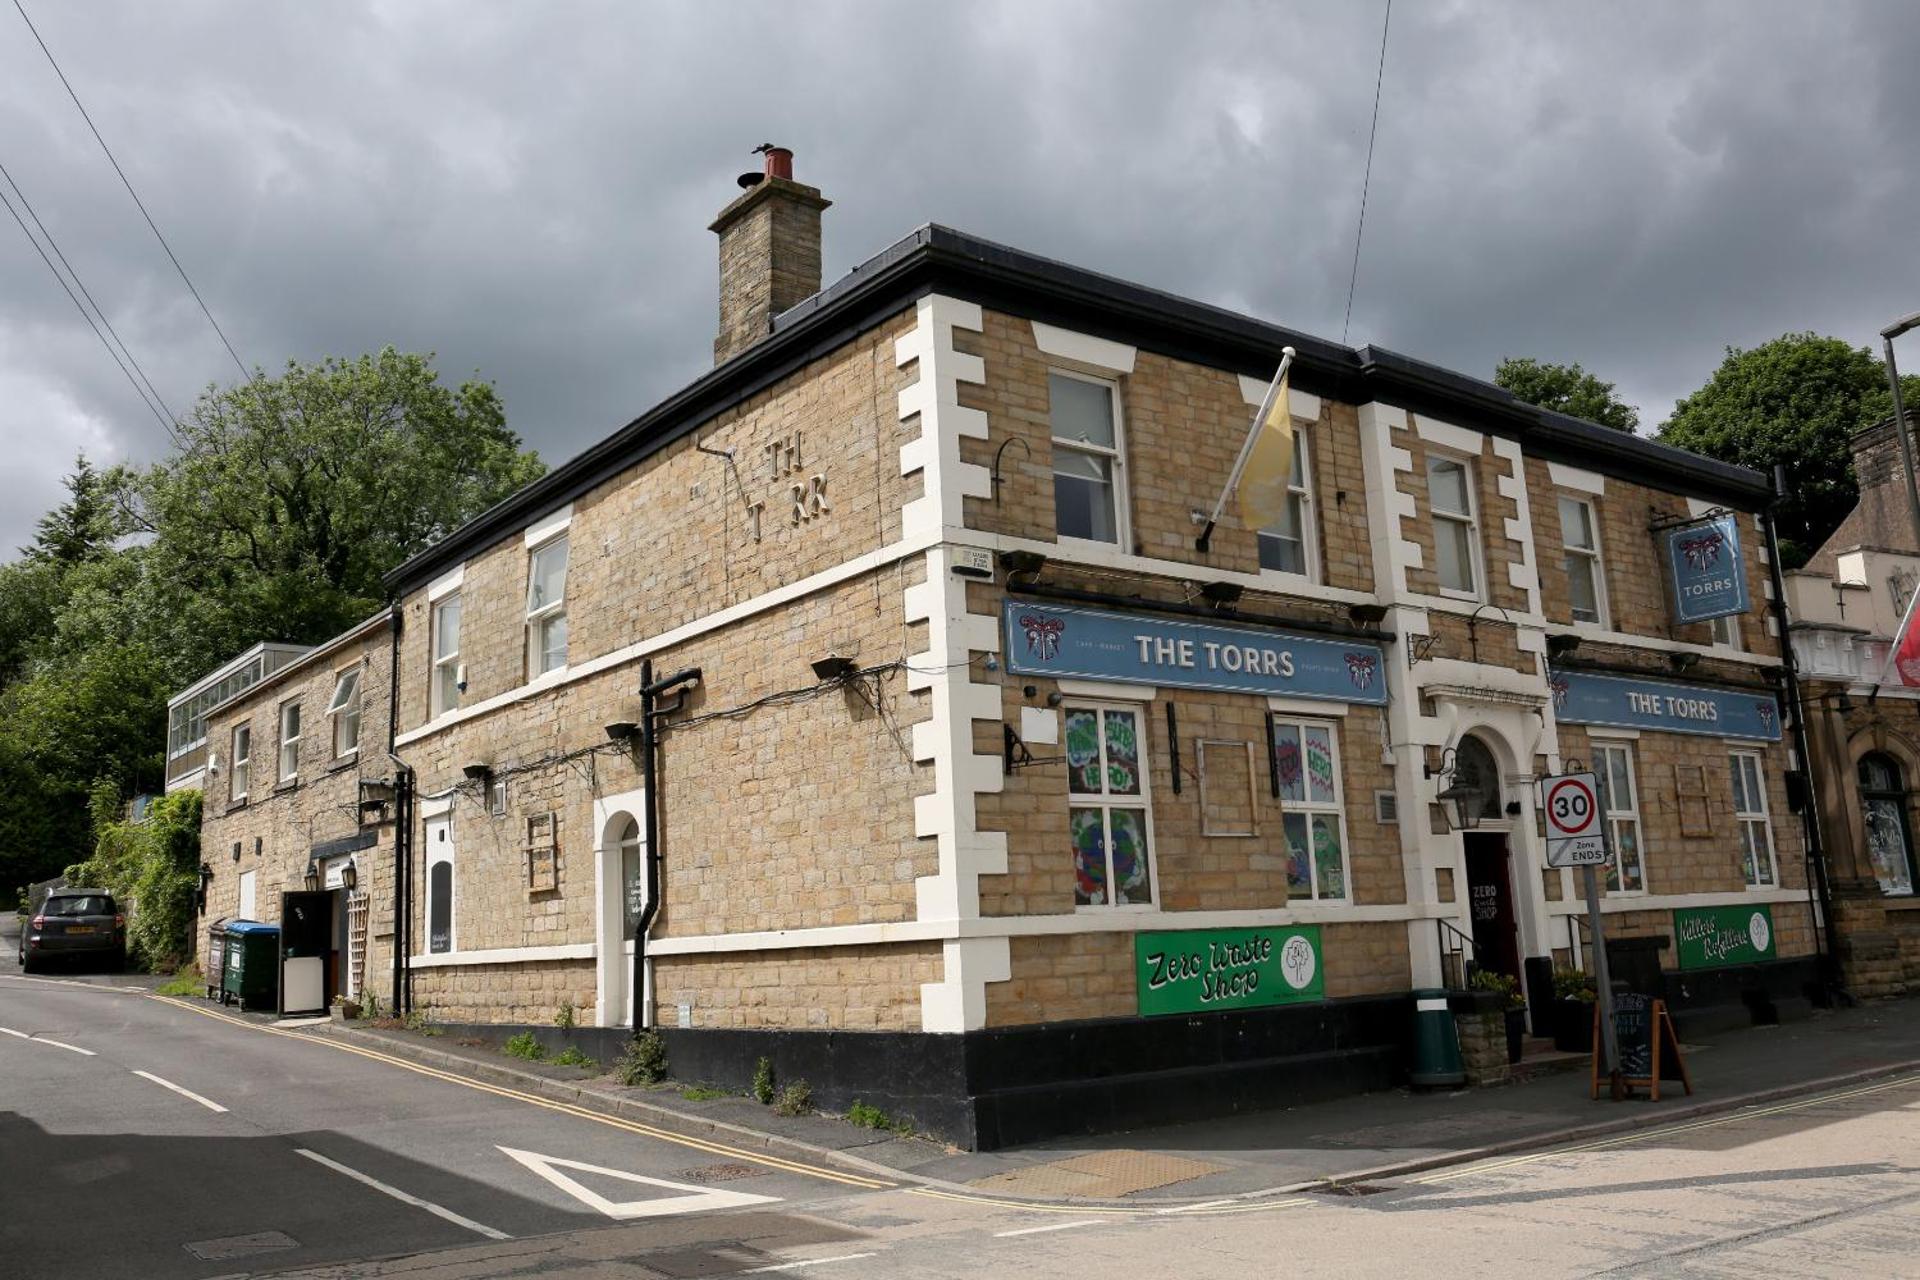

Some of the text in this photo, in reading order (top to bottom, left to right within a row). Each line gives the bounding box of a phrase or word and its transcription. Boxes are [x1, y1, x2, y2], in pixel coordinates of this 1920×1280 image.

[1683, 578, 1732, 598] TORRS
[1134, 635, 1295, 677] THE TORRS
[1625, 691, 1718, 721] THE TORRS
[1554, 795, 1588, 818] 30
[1571, 850, 1603, 861] ENDS
[1576, 841, 1596, 850] Zone
[1472, 885, 1497, 898] ZERO
[1146, 935, 1271, 990] Zero Waste
[1200, 967, 1259, 1002] Shop
